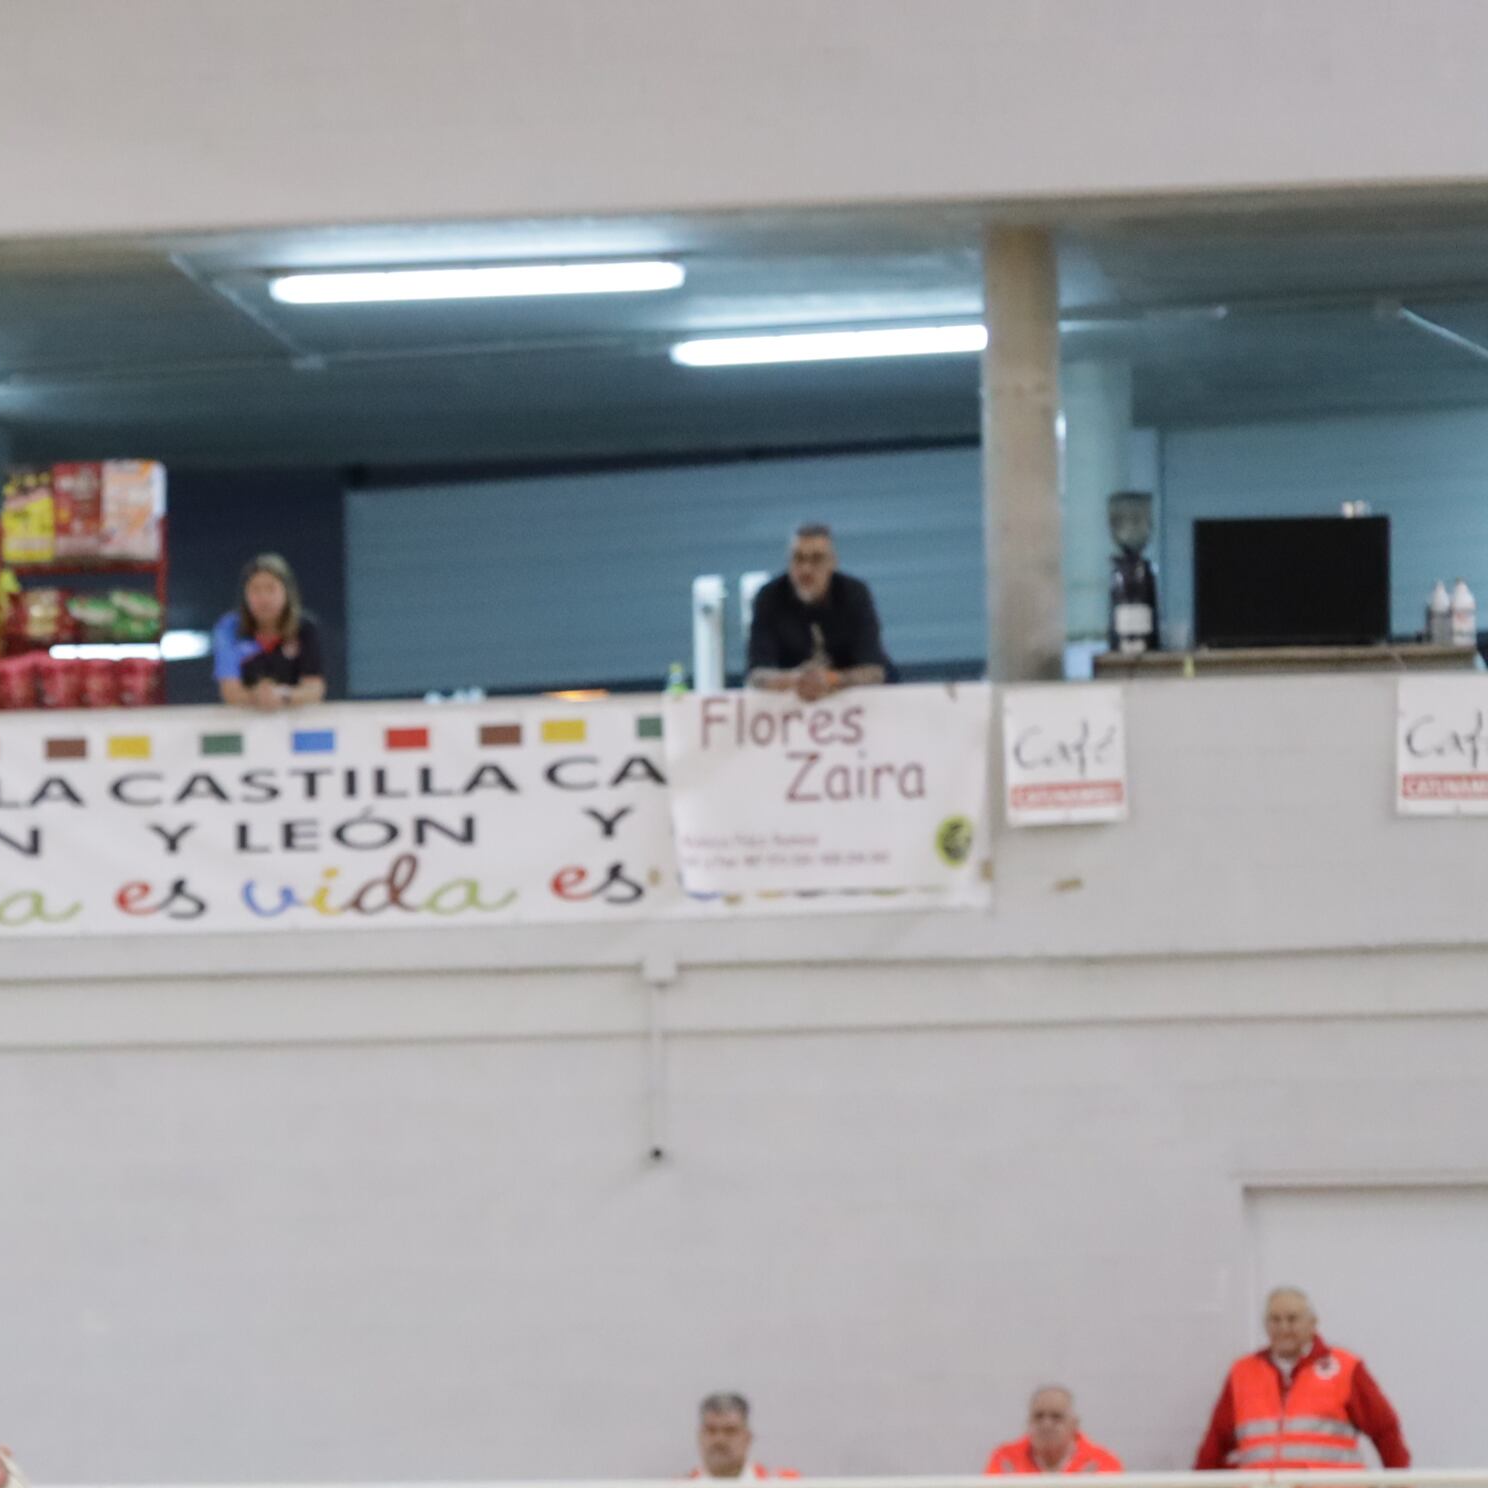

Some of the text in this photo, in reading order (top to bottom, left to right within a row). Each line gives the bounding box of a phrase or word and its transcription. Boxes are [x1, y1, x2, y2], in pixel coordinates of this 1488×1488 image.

[700, 697, 866, 748] Flores
[107, 763, 521, 806] CASTILLA
[785, 751, 928, 803] Zaira
[148, 823, 197, 853] Y
[235, 807, 475, 853] LEÓN
[585, 806, 633, 840] Y
[114, 880, 208, 920] es
[240, 853, 517, 917] vida
[551, 860, 644, 904] es
